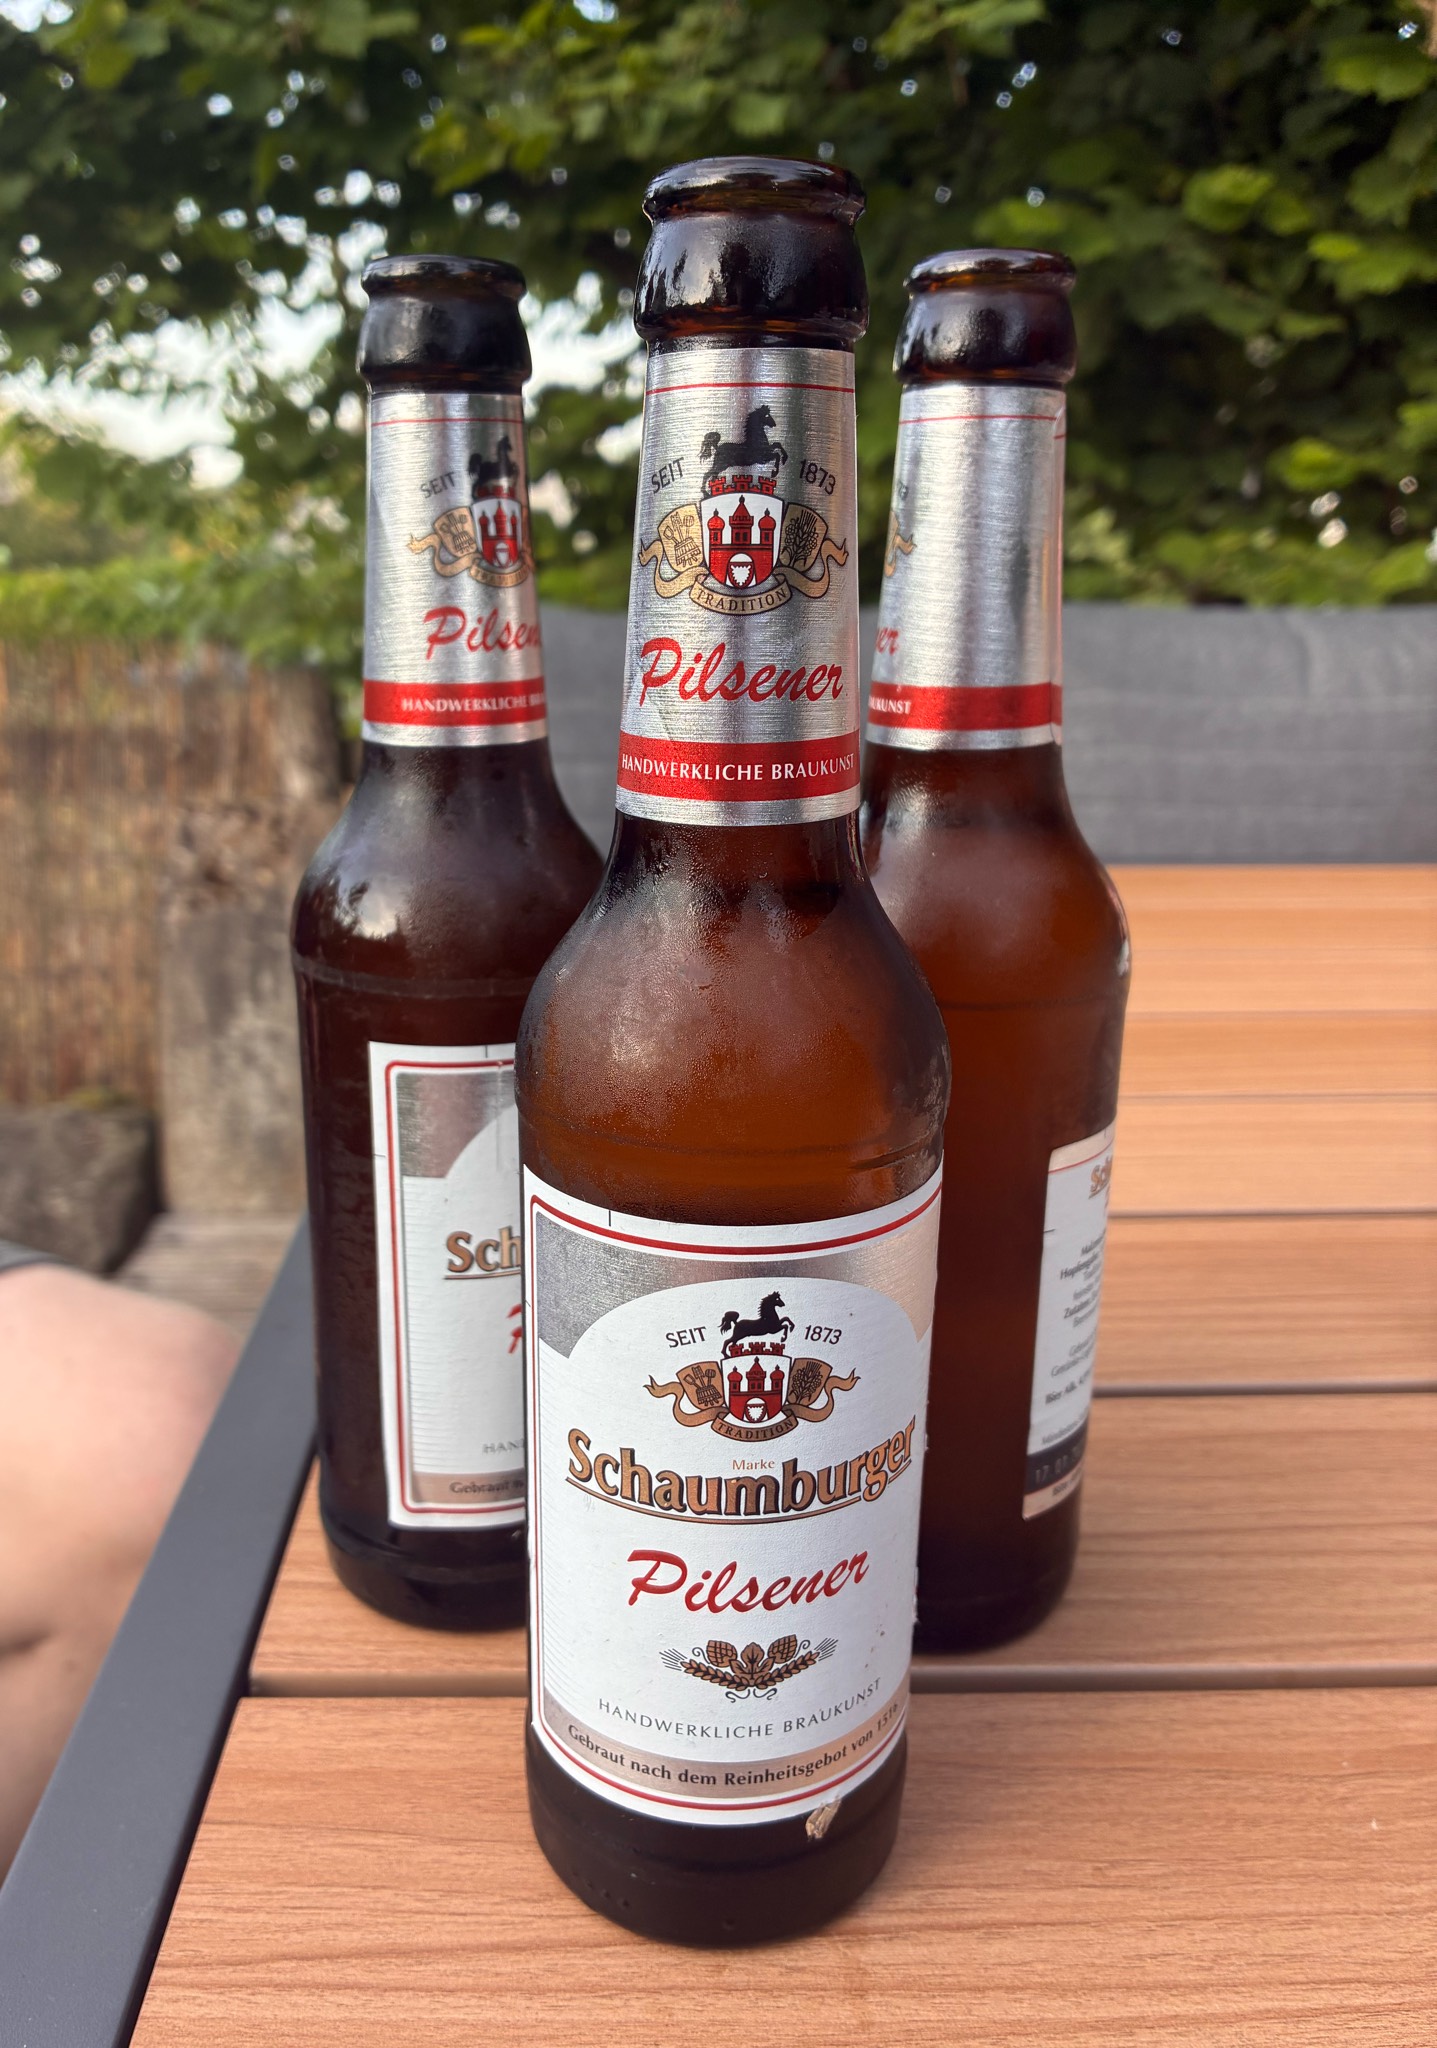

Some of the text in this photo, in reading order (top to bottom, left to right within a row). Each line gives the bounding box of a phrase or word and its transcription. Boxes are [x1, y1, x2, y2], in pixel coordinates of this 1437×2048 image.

[420, 471, 456, 498] SEIT
[651, 457, 838, 495] SEIT 1873
[695, 588, 788, 613] TRADITION
[640, 637, 843, 707] Pilsener
[621, 753, 856, 782] HANDWERKLICHE BRAUKUNST
[665, 1325, 842, 1348] SEIT 1873
[717, 1419, 794, 1441] TRADITION
[567, 1415, 916, 1516] Schaumburger
[732, 1457, 775, 1472] Marke
[627, 1549, 870, 1614] Pilsener
[599, 1677, 881, 1740] HANDWERKLICHE BRAUKUNST
[568, 1724, 626, 1768] Gebraut
[630, 1757, 672, 1781] nach
[678, 1768, 717, 1786] dem
[724, 1745, 848, 1786] Reinheitsgebot
[851, 1730, 873, 1751] von
